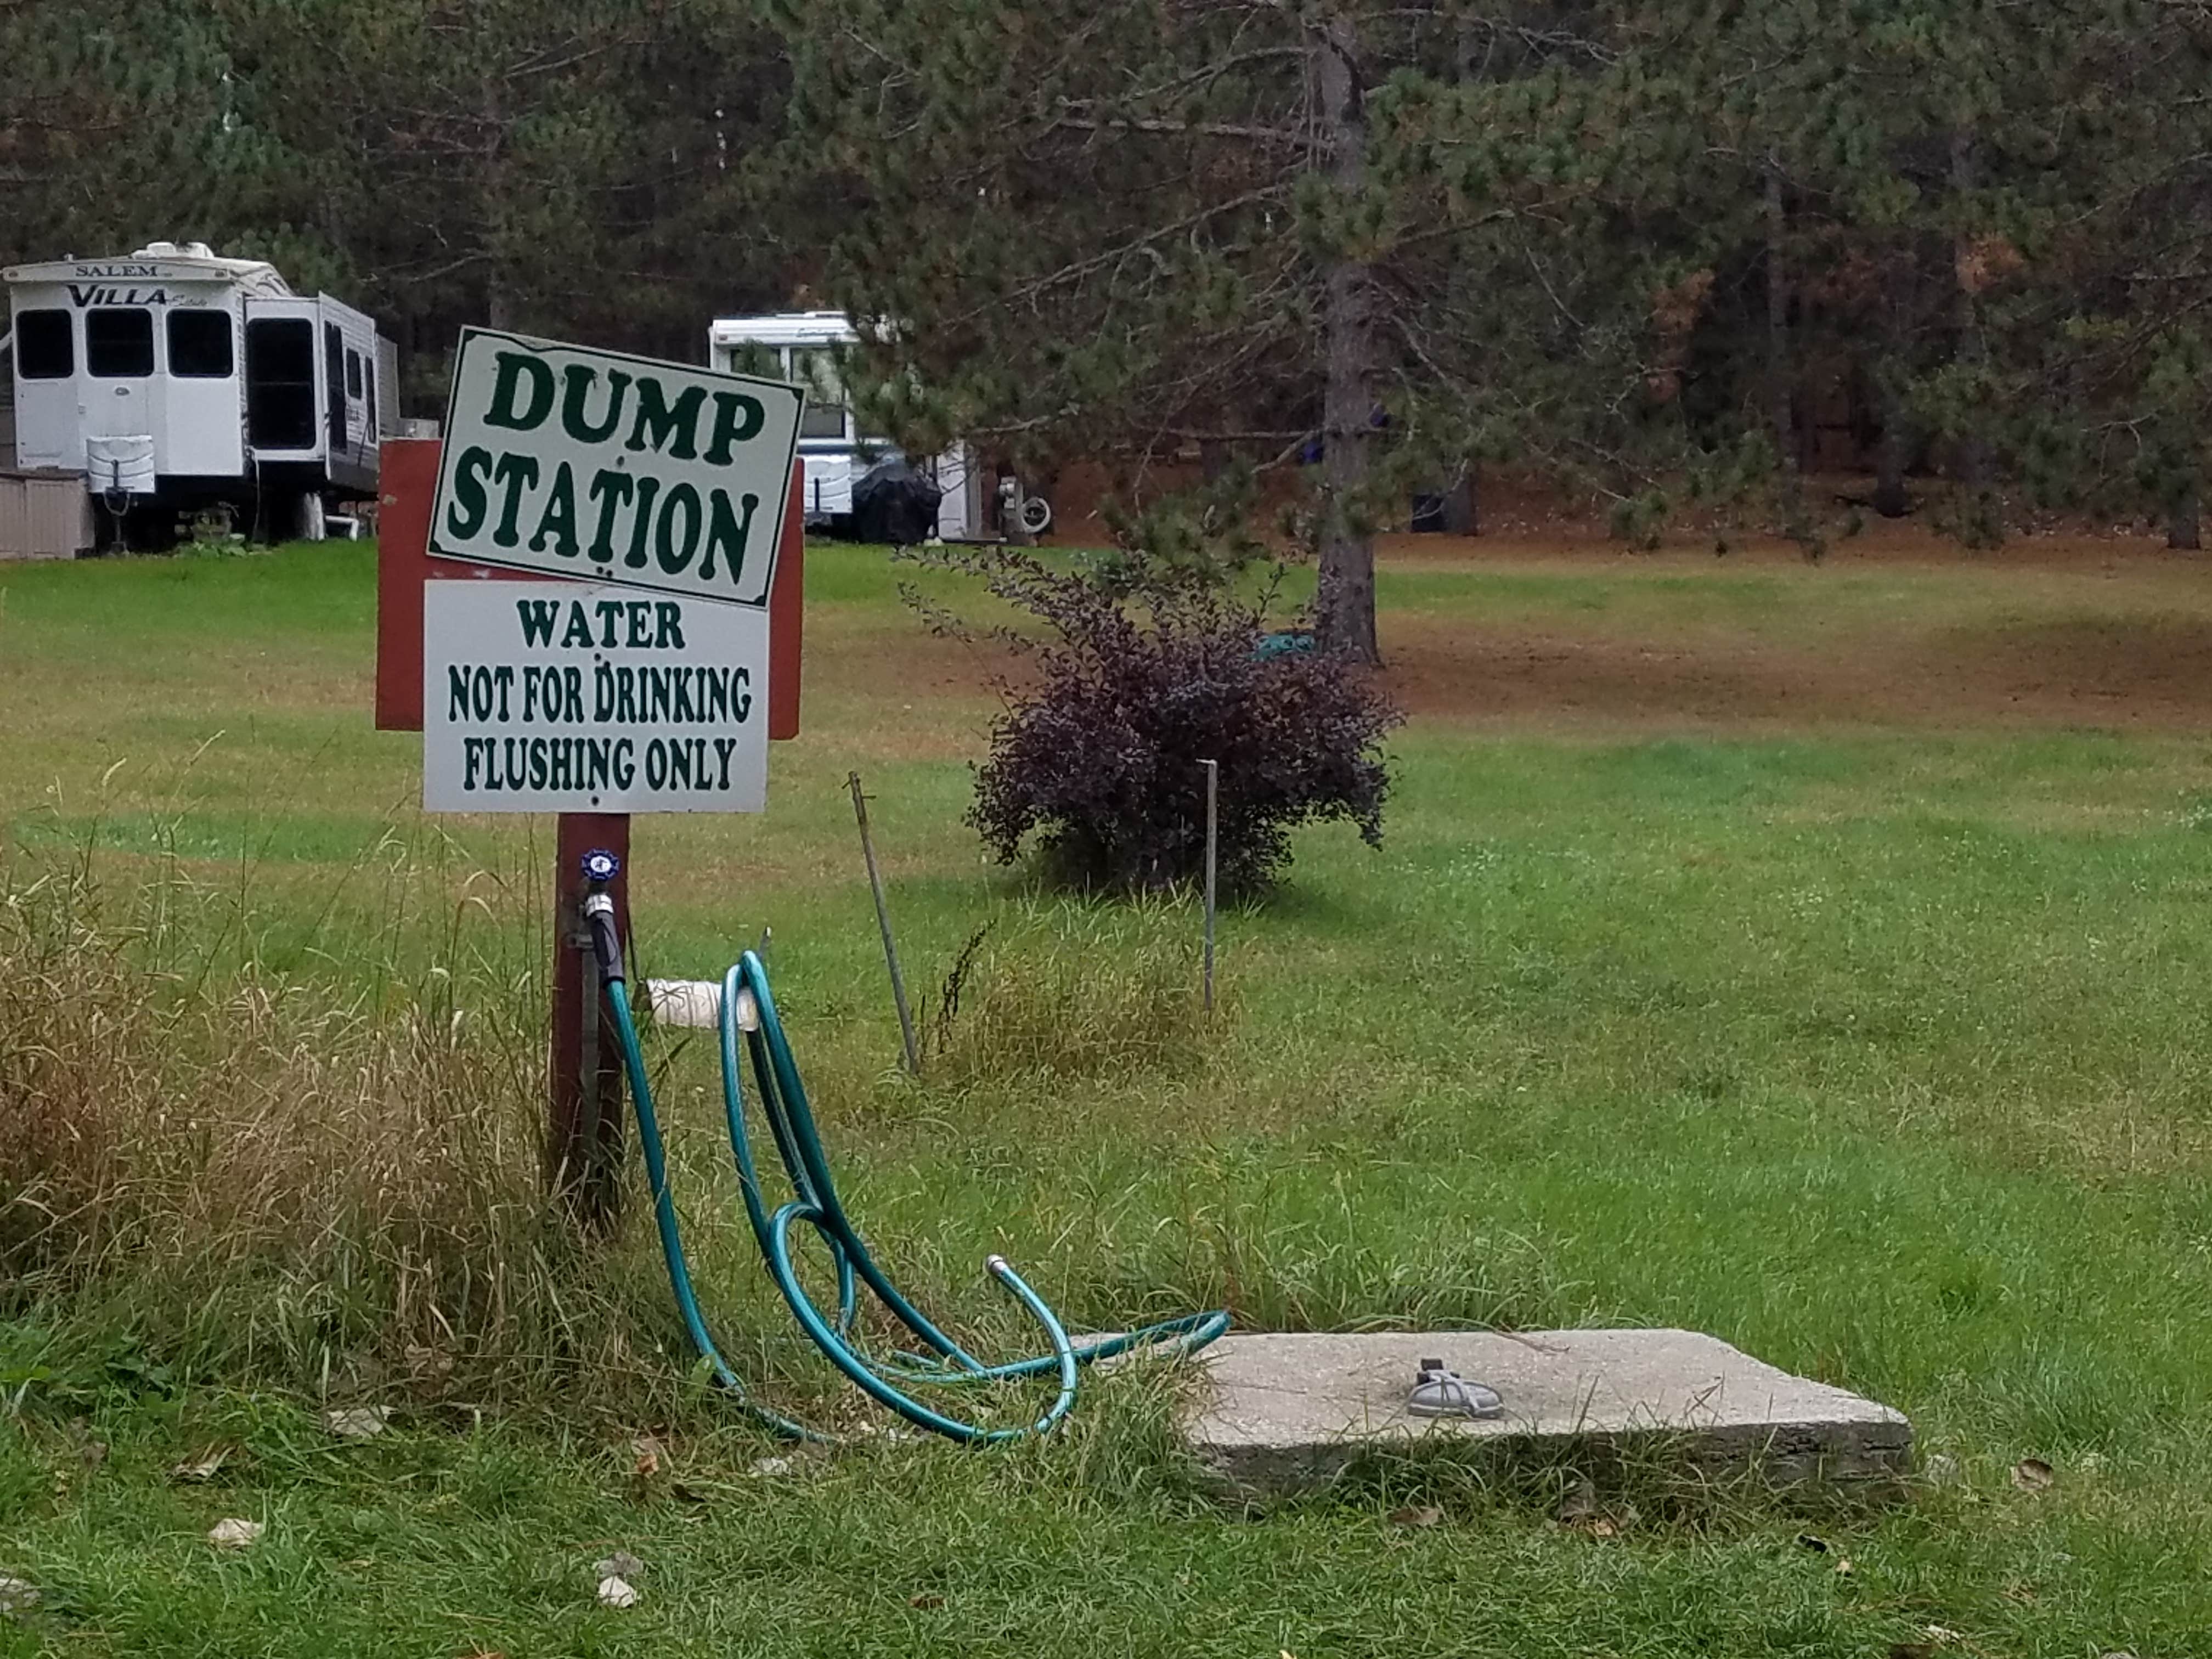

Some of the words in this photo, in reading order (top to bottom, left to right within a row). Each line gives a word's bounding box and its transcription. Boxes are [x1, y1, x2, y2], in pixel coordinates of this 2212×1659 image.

[67, 285, 166, 307] VILLA
[75, 266, 158, 277] SALEM
[483, 351, 765, 466] DUMP
[448, 446, 759, 585] STATION
[517, 600, 685, 649] WATER
[449, 665, 514, 722] NOT
[523, 666, 584, 723] FOR
[594, 665, 751, 723] DRINKING
[464, 737, 635, 791] FLUSHING
[646, 738, 736, 791] ONLY
